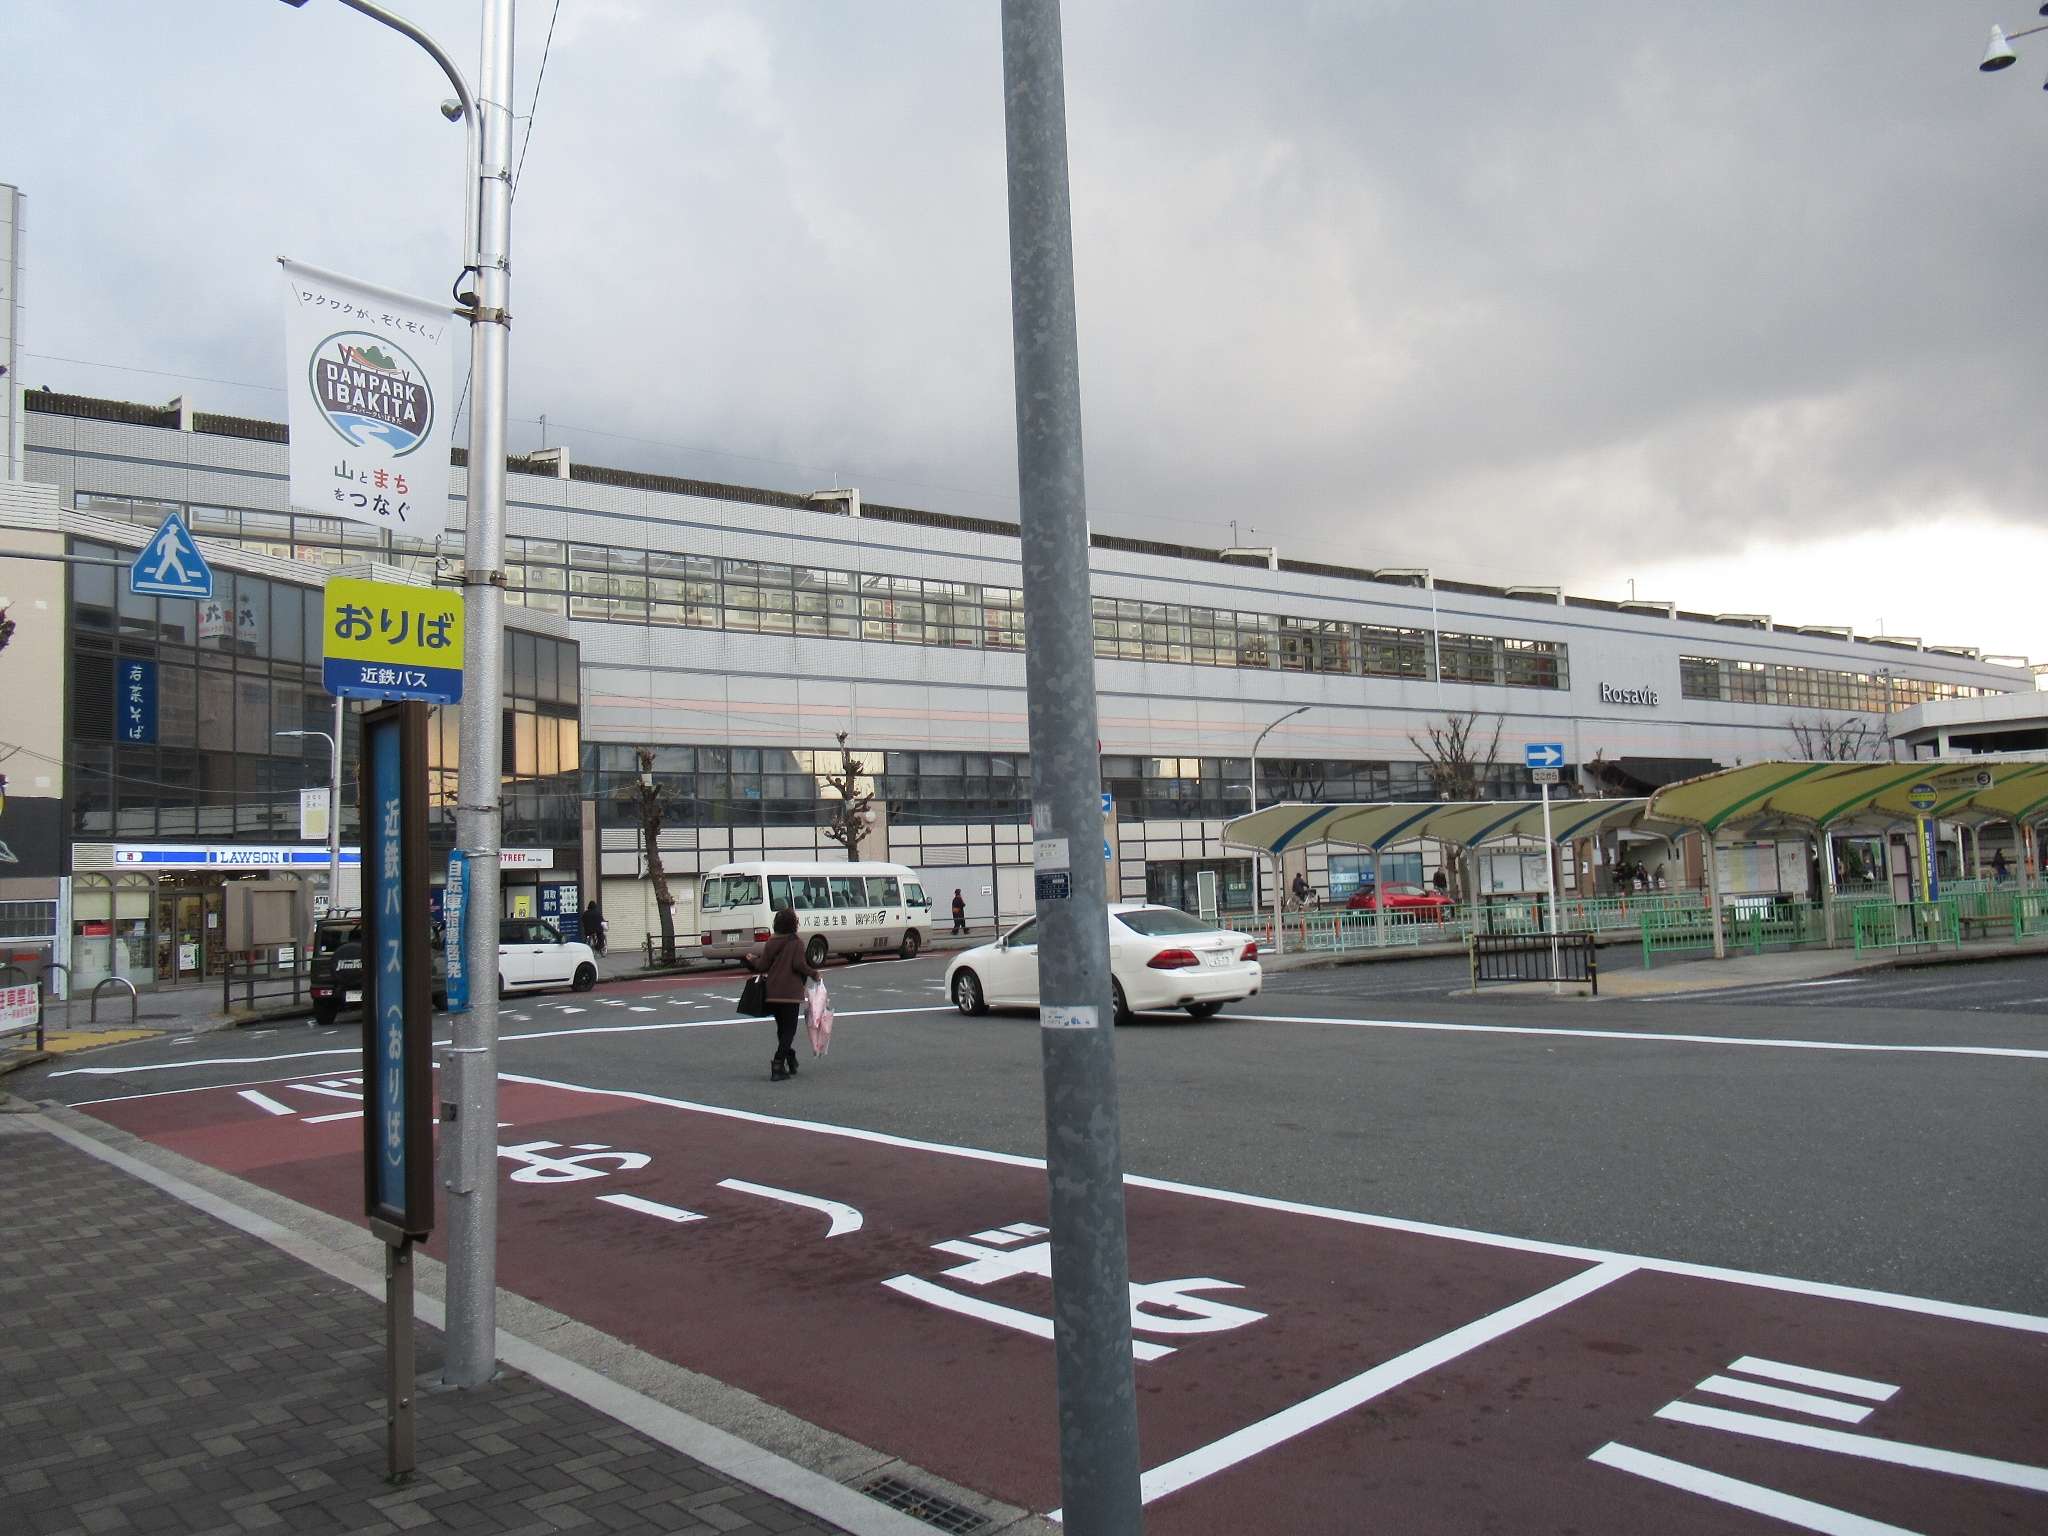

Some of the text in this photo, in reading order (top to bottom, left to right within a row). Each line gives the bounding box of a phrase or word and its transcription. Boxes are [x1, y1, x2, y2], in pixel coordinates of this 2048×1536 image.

[327, 363, 416, 403] DAMPARK
[328, 380, 416, 423] IBAKITA
[334, 459, 408, 495] 山とまち
[334, 487, 411, 522] をつなぐ
[335, 603, 455, 649] おりば
[360, 667, 428, 688] 近鉄バス
[1600, 681, 1659, 706] Rosavia
[220, 851, 279, 864] LAWSON
